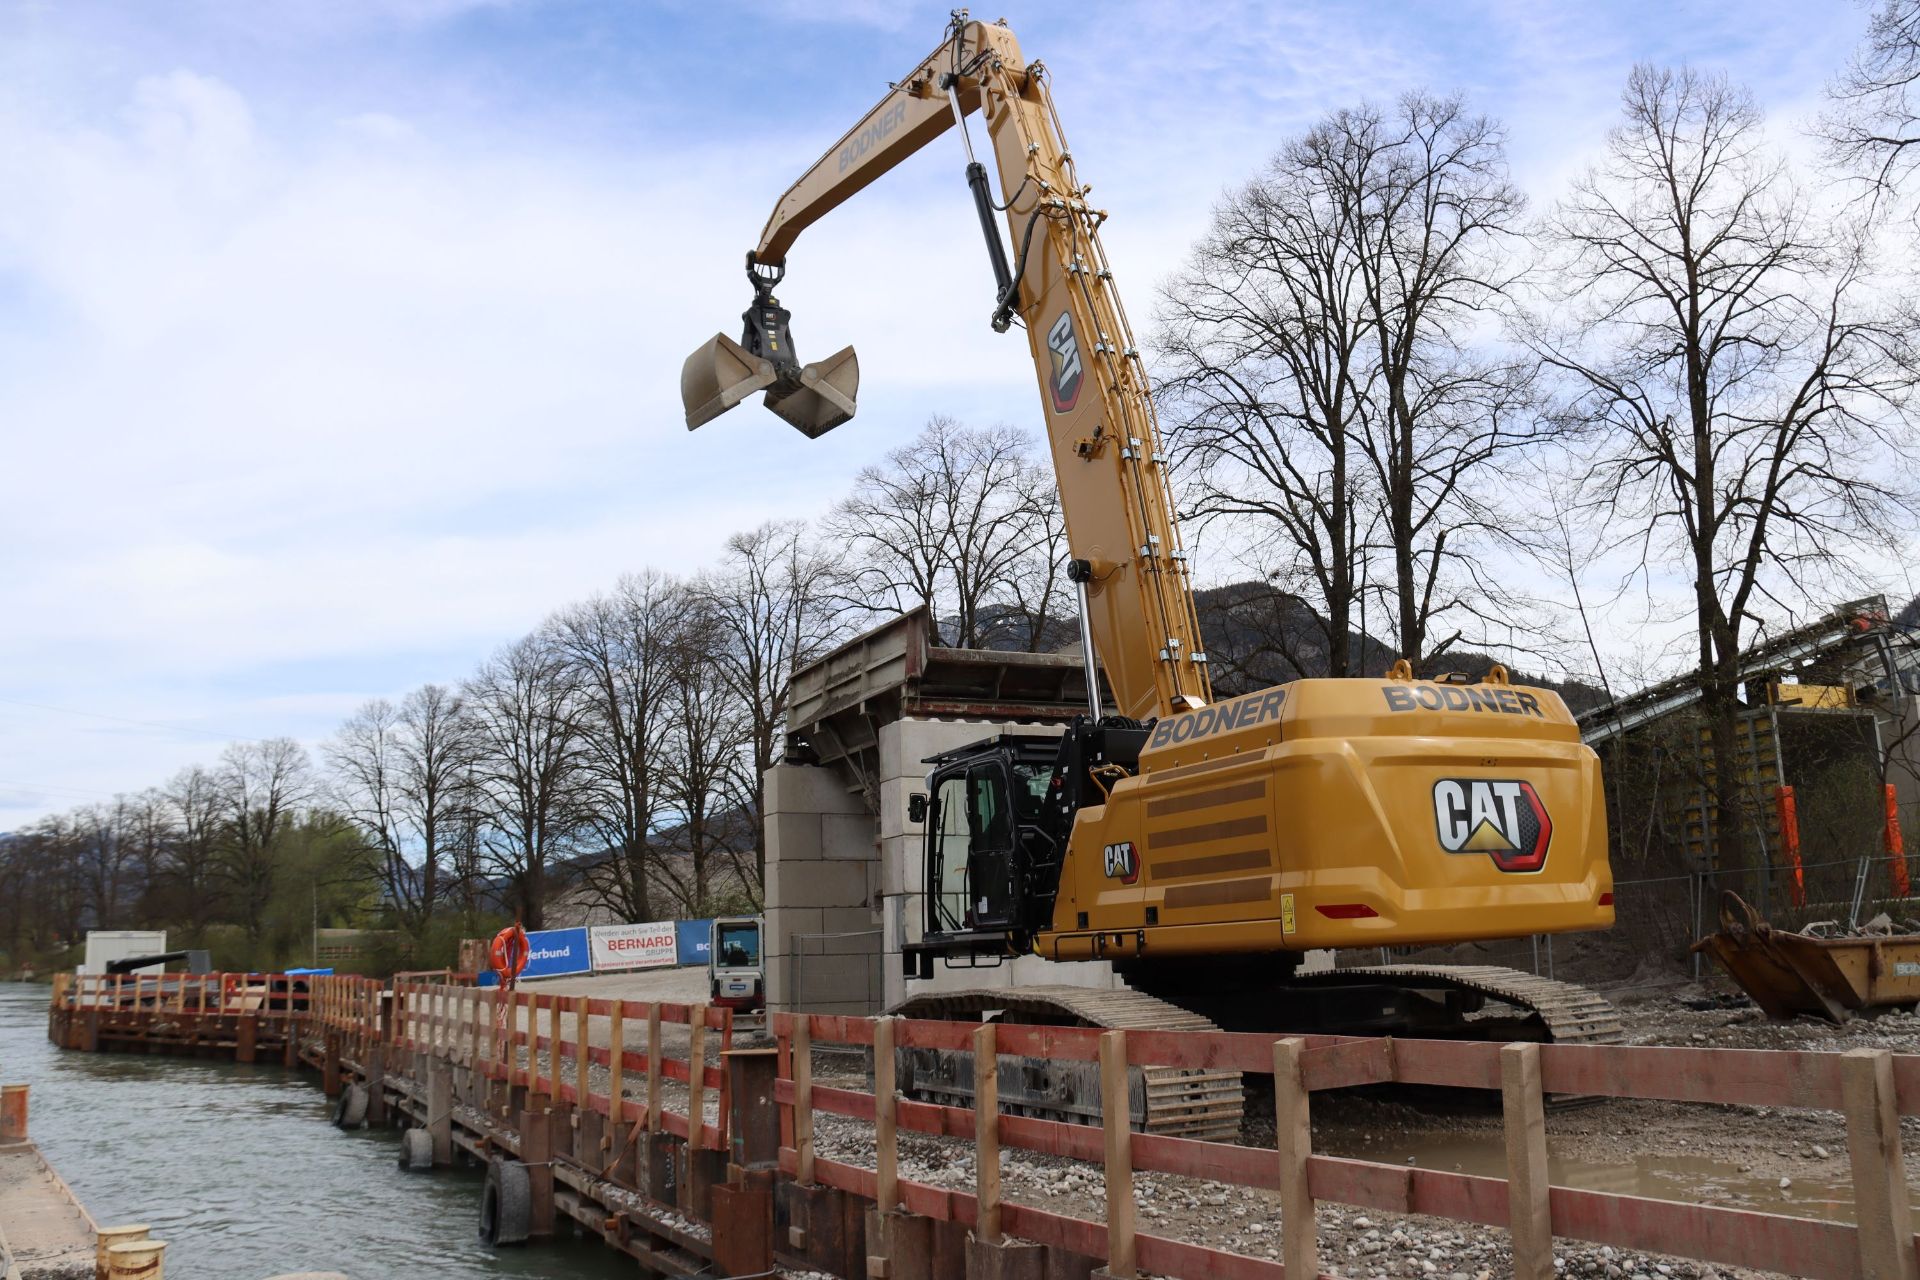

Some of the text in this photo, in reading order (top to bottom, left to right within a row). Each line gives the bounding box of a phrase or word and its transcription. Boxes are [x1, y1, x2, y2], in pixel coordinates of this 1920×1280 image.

[837, 99, 906, 174] BODNER
[1048, 312, 1082, 391] CAT
[1382, 686, 1544, 718] BODNER
[1151, 691, 1285, 749] BODNER
[1434, 780, 1521, 850] CAT
[1104, 843, 1130, 877] CAT
[608, 936, 674, 951] BERNARD
[621, 928, 637, 936] auch
[645, 948, 675, 956] GRUPPE
